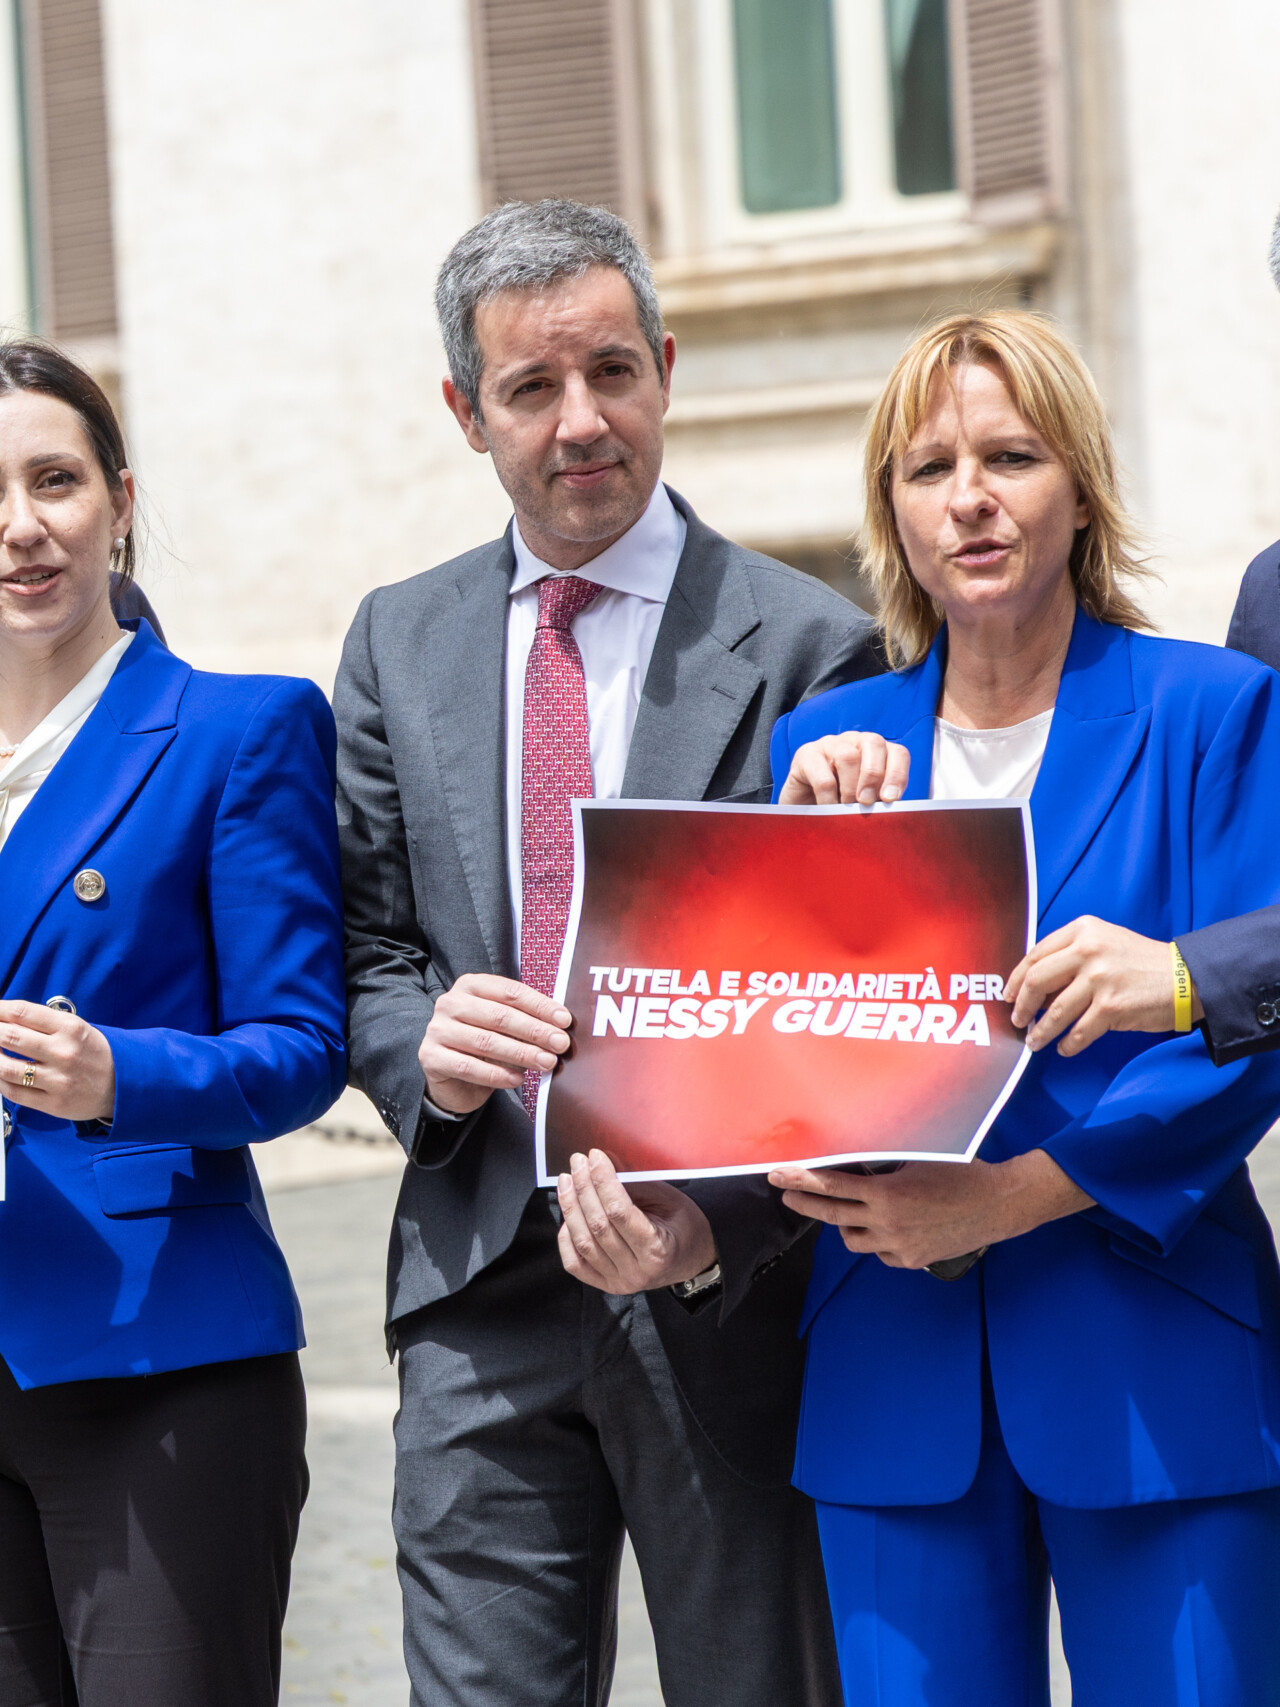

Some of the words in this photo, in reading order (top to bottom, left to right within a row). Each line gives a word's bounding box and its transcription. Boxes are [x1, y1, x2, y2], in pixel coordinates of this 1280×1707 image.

[589, 967, 710, 996] TUTELA
[720, 971, 741, 997] E
[745, 967, 941, 1000] SOLIDARIETÀ
[948, 974, 1005, 1001] PER
[592, 995, 769, 1038] NESSY
[772, 999, 991, 1047] GUERRA
